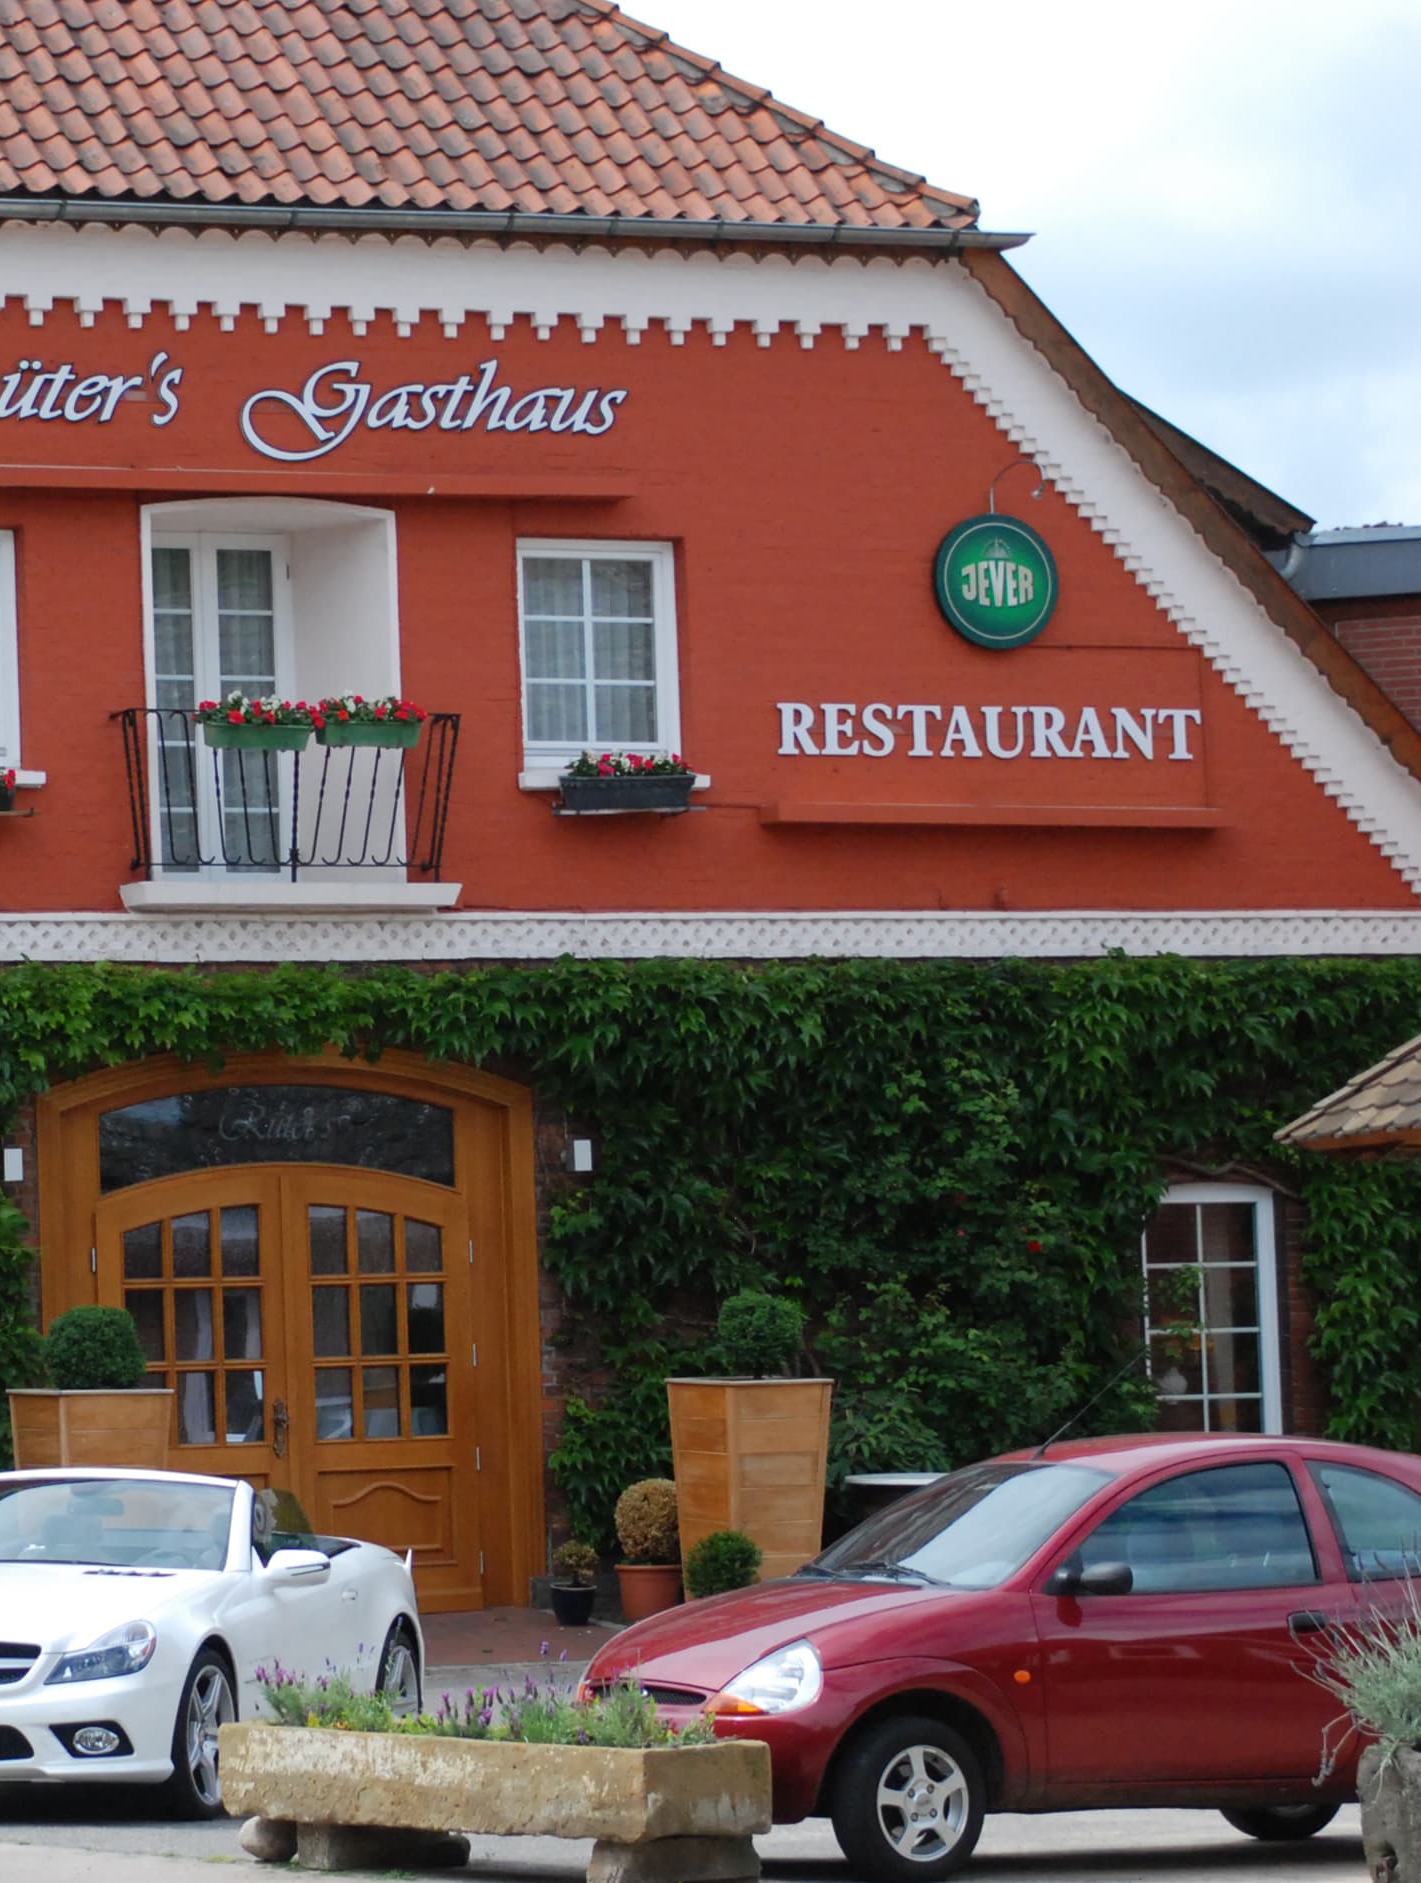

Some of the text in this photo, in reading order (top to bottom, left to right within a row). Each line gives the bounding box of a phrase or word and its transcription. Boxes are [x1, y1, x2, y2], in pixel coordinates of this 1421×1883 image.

[240, 360, 626, 462] Gasthaus
[961, 560, 1034, 607] JEVER
[777, 702, 1202, 760] RESTAURANT
